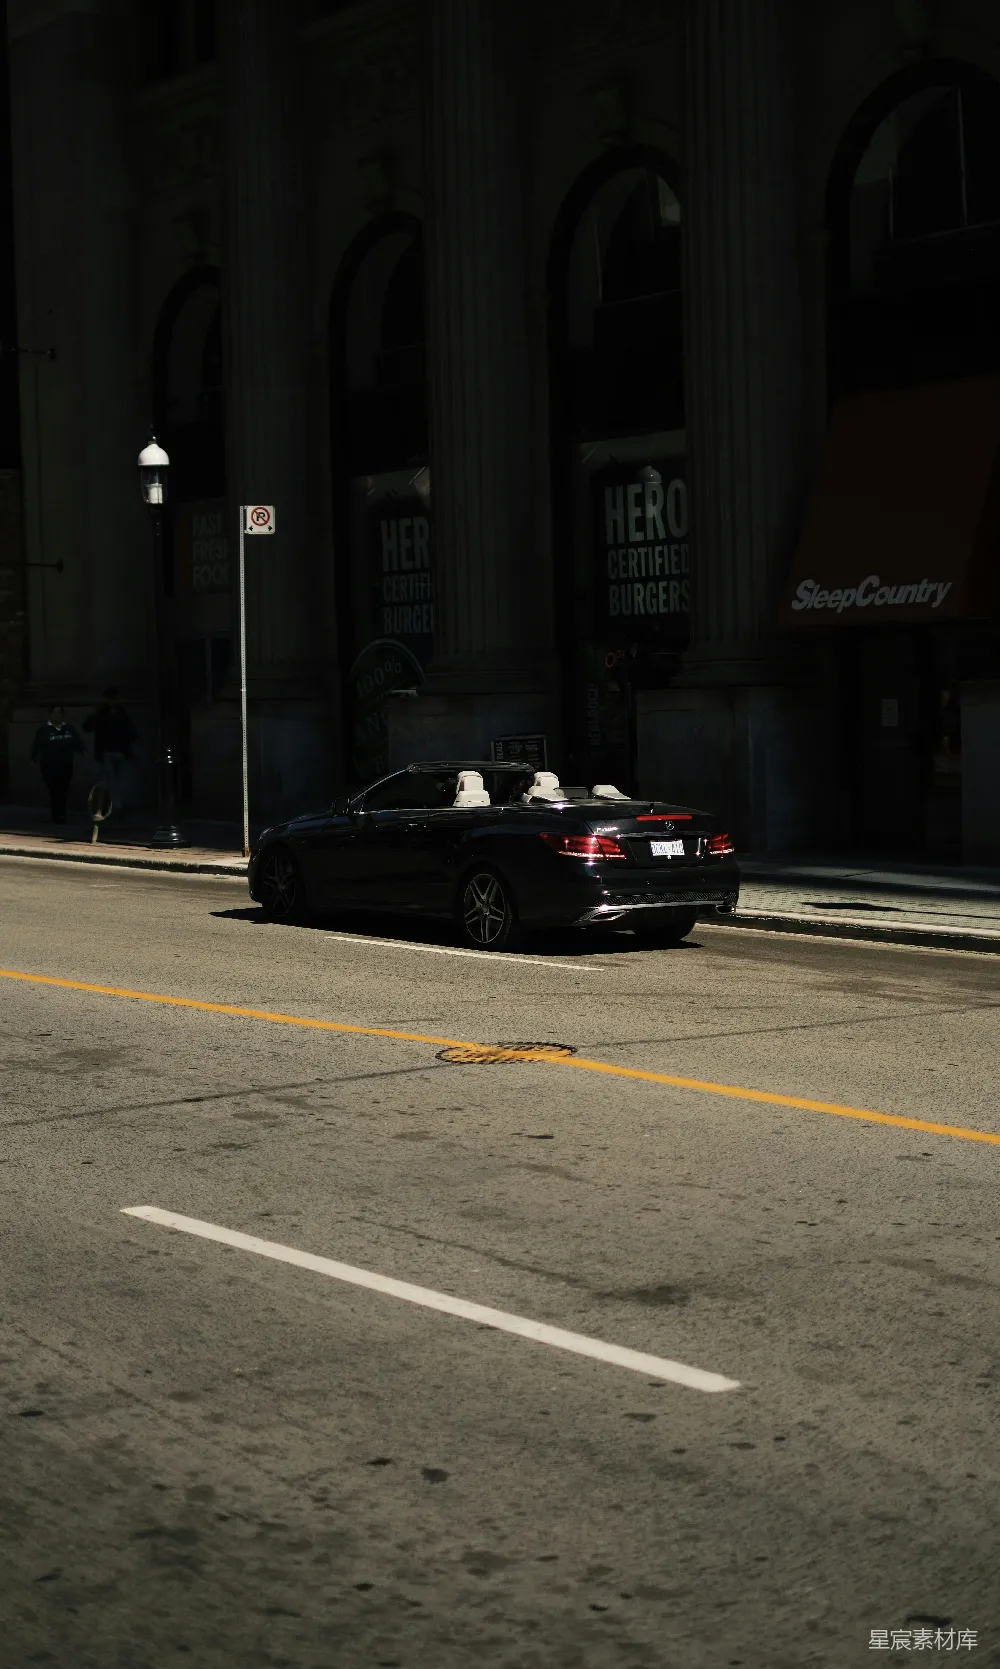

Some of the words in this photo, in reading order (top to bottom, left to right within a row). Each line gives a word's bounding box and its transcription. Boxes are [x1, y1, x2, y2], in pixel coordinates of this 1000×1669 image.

[192, 513, 222, 538] FAST
[604, 478, 689, 545] HERO
[607, 543, 690, 581] CERTIFIED
[608, 579, 691, 617] BURGERS
[791, 575, 953, 613] SleepCountry
